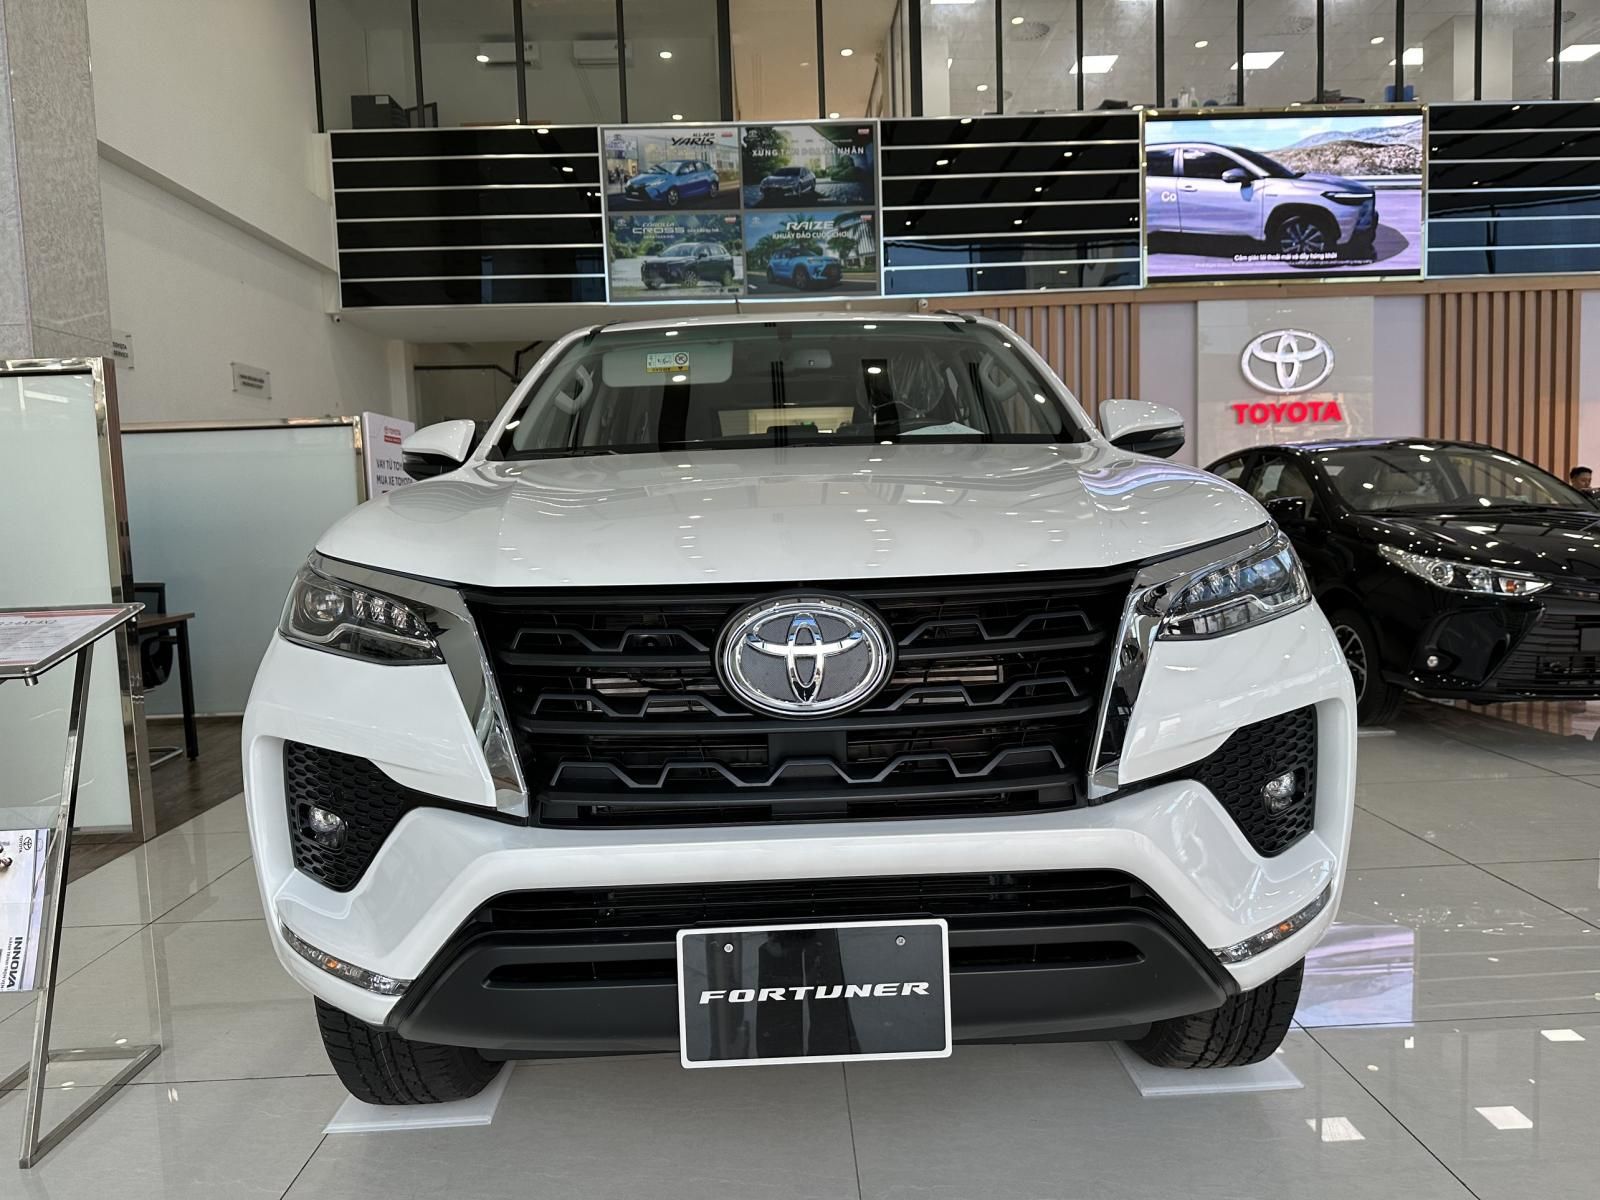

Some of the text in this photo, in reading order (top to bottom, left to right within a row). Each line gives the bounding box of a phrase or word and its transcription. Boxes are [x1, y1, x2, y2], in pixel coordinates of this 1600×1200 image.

[671, 136, 715, 146] YARIS
[786, 220, 834, 231] RAIZE
[1232, 401, 1342, 424] TOYOTA
[6, 936, 23, 988] INNOVA
[699, 982, 930, 1004] FORTUNER
